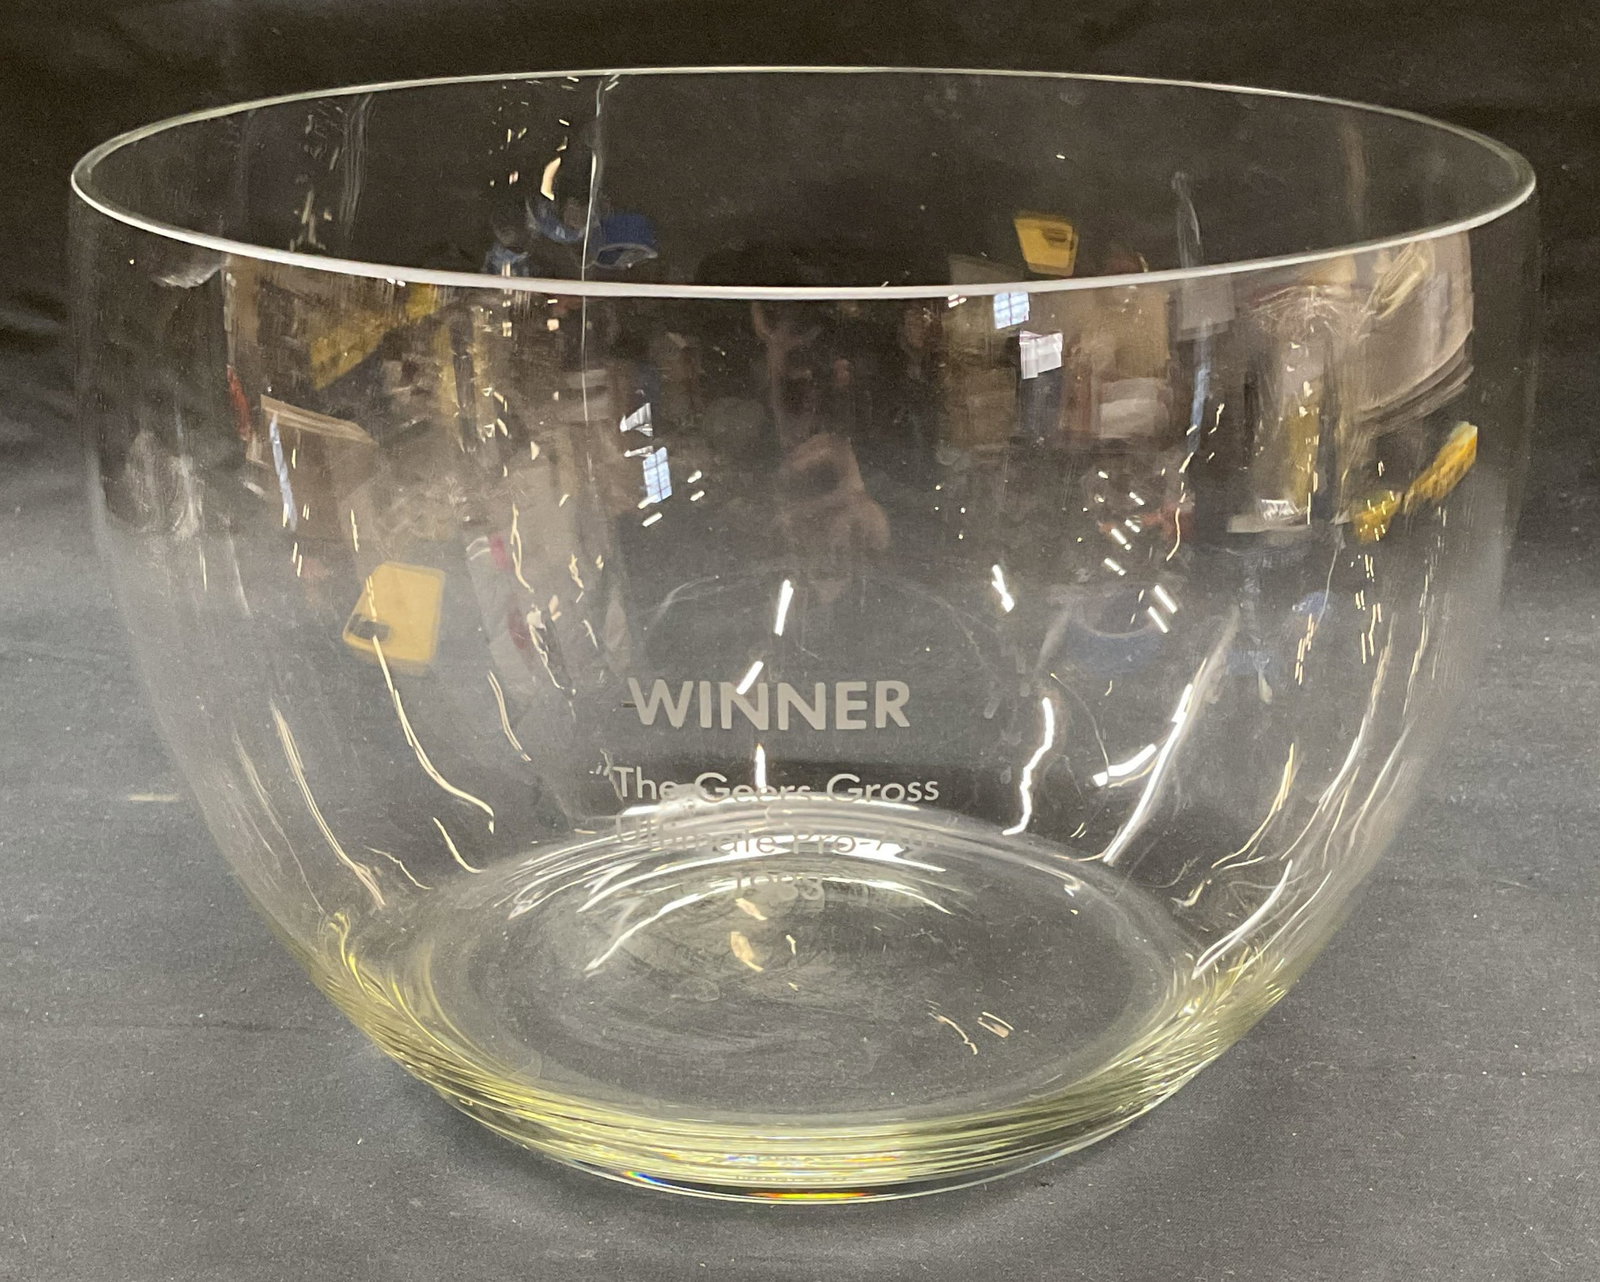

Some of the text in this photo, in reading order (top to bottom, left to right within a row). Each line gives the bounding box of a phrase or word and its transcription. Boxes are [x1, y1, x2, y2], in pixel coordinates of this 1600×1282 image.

[628, 677, 911, 731] WINNER
[612, 765, 939, 804] The Geers Gross
